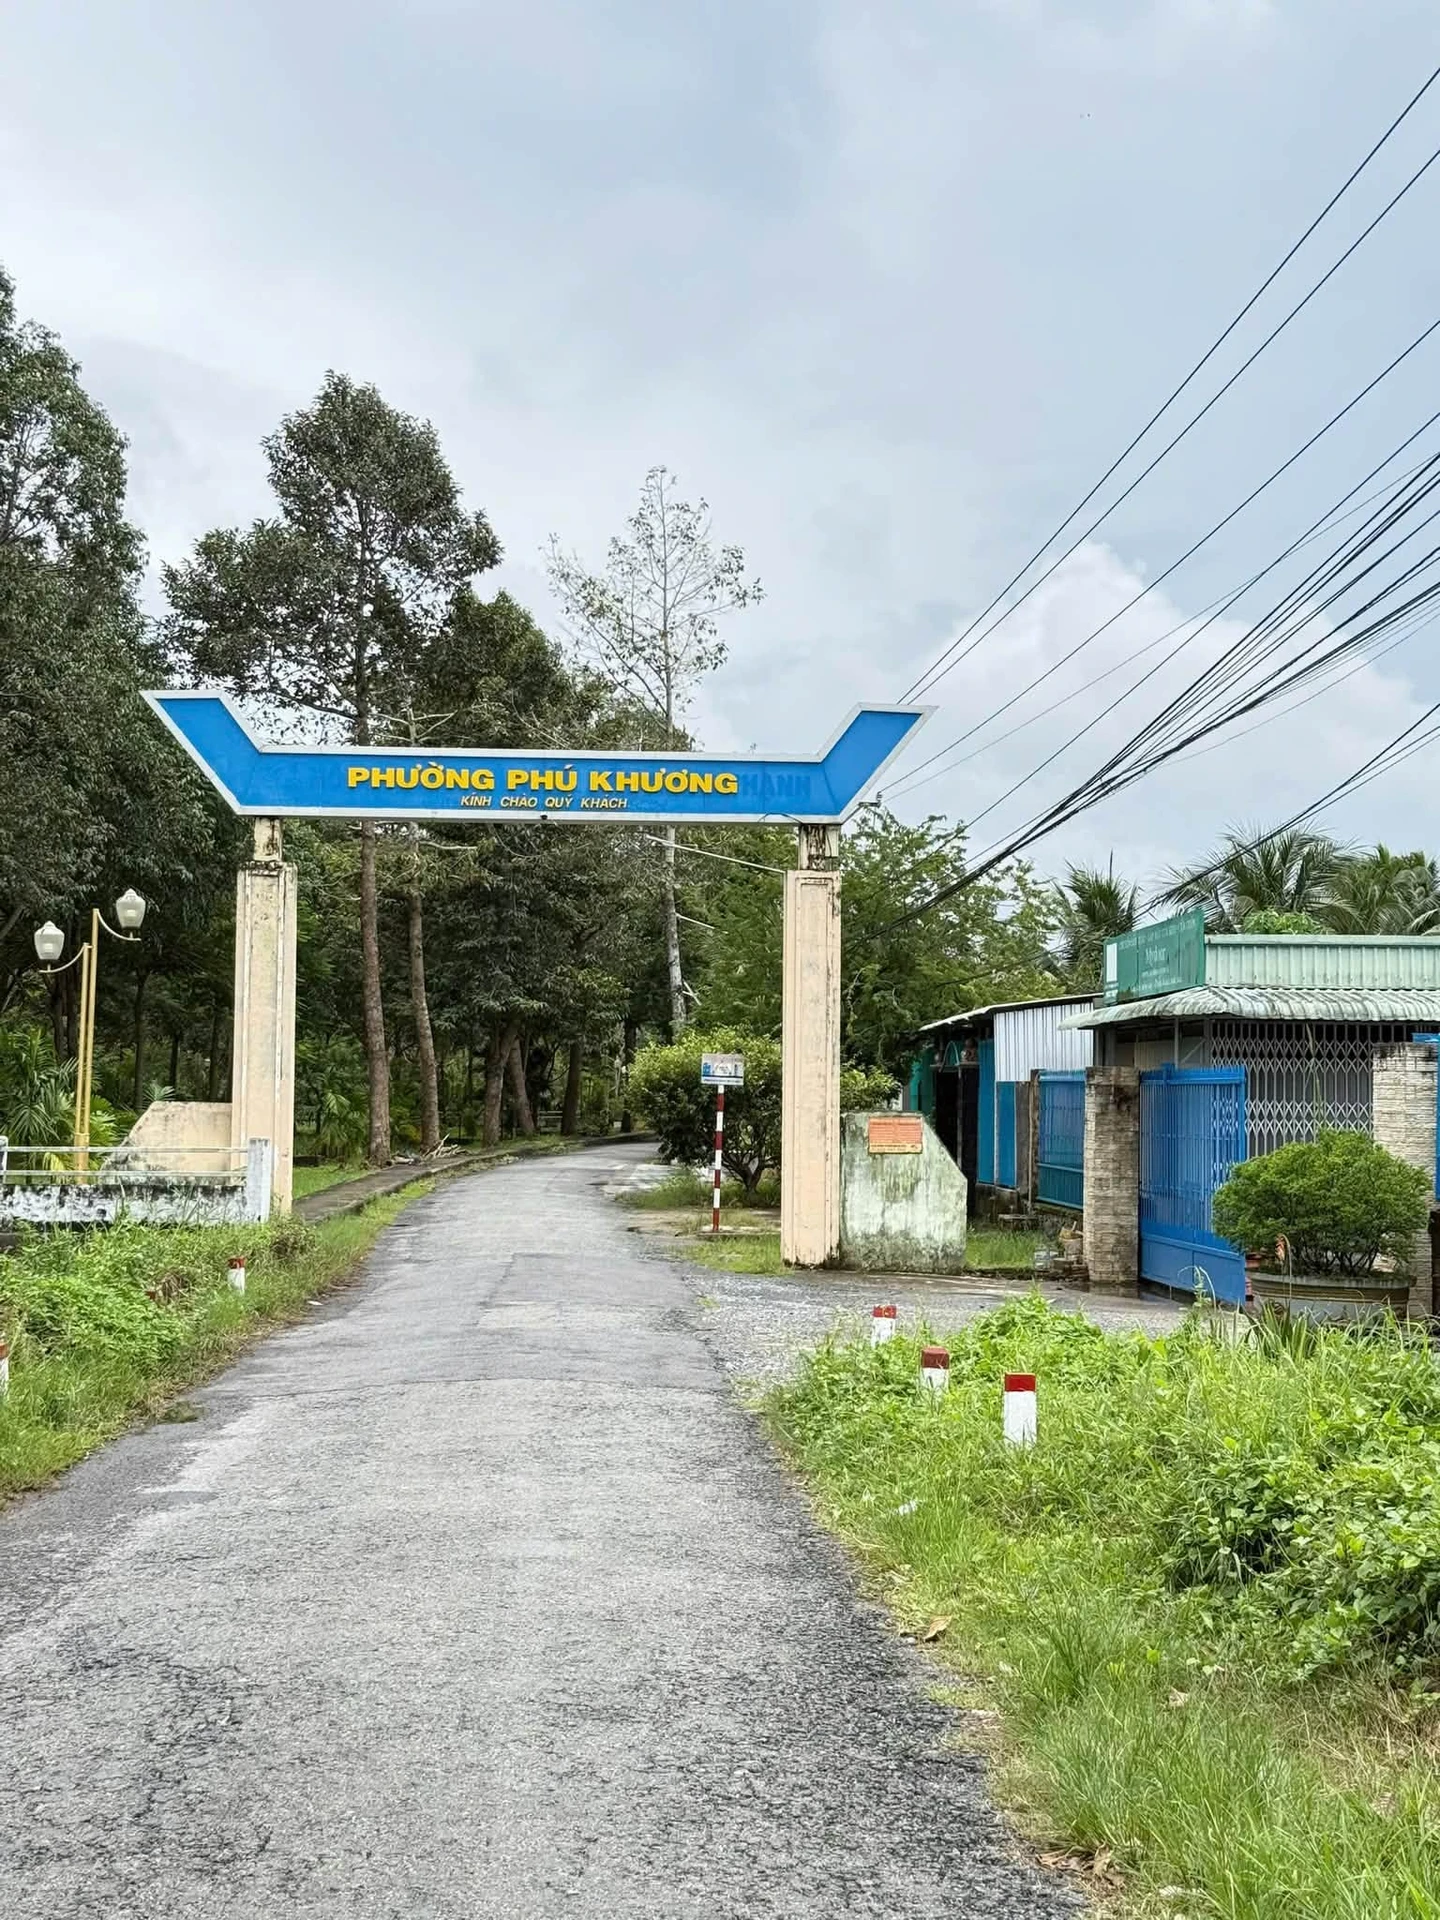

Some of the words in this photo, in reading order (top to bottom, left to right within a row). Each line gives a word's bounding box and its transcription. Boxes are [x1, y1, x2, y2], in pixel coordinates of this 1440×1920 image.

[347, 761, 495, 790] PHƯỜNG
[507, 763, 578, 791] PHÚ
[589, 767, 739, 794] KHƯƠNG
[460, 791, 492, 807] KÍNH
[500, 793, 538, 808] CHÀO
[544, 793, 574, 808] QUÝ
[580, 794, 629, 809] KHÁCH
